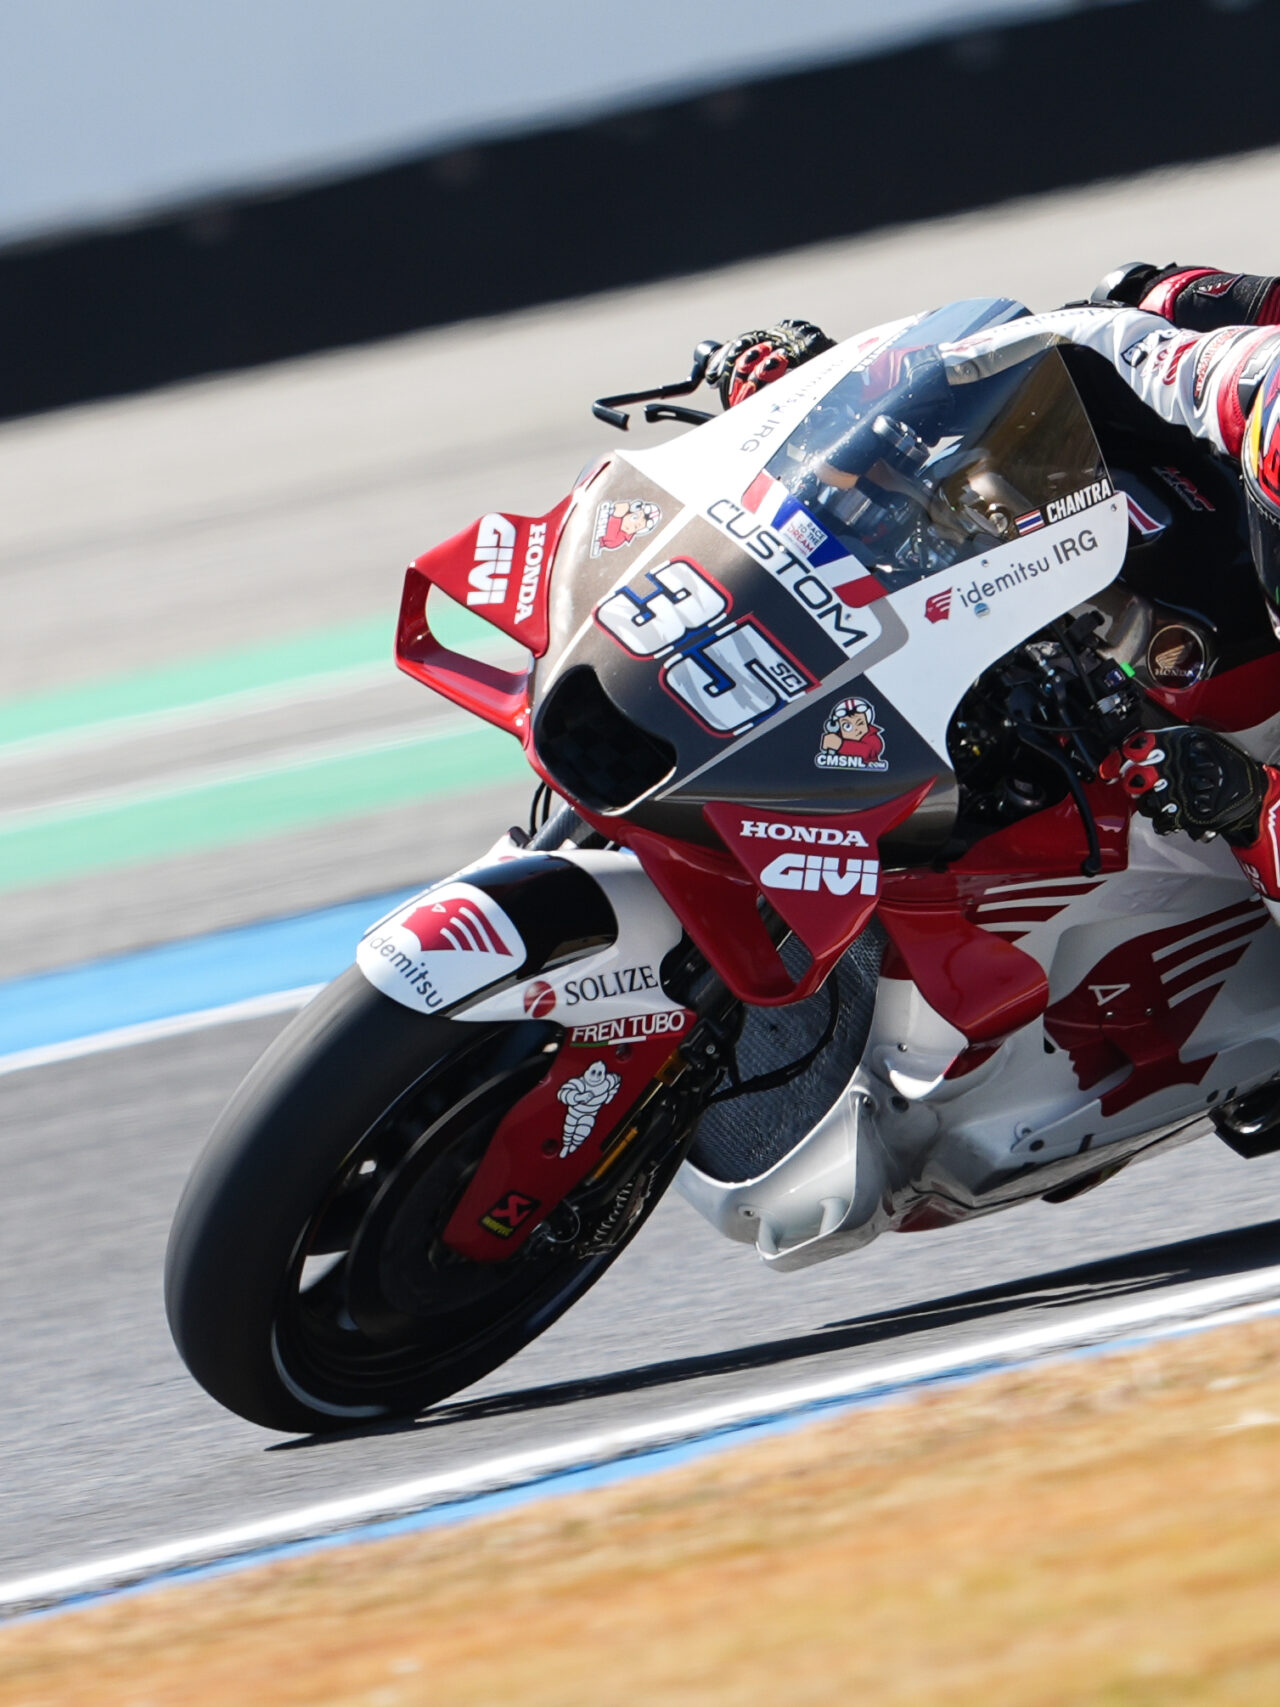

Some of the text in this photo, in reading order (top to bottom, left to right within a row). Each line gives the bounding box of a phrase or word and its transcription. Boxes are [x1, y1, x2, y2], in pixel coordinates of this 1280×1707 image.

[1046, 478, 1112, 524] CHANTRA
[785, 523, 814, 553] DREAM
[806, 520, 827, 540] RACE
[806, 533, 822, 546] THE
[466, 512, 517, 606] GIVI
[513, 522, 548, 625] HONDA
[706, 499, 869, 649] CUSTOM
[956, 529, 1099, 608] idemitsu IRG
[593, 556, 822, 738] 35
[769, 662, 803, 688] SC
[816, 753, 867, 768] CMSNL
[739, 820, 870, 848] HONDA
[759, 852, 880, 896] GIVI
[368, 935, 444, 1008] demitsu
[564, 965, 659, 1006] SOLIZE
[571, 1010, 686, 1042] FREN TUBO
